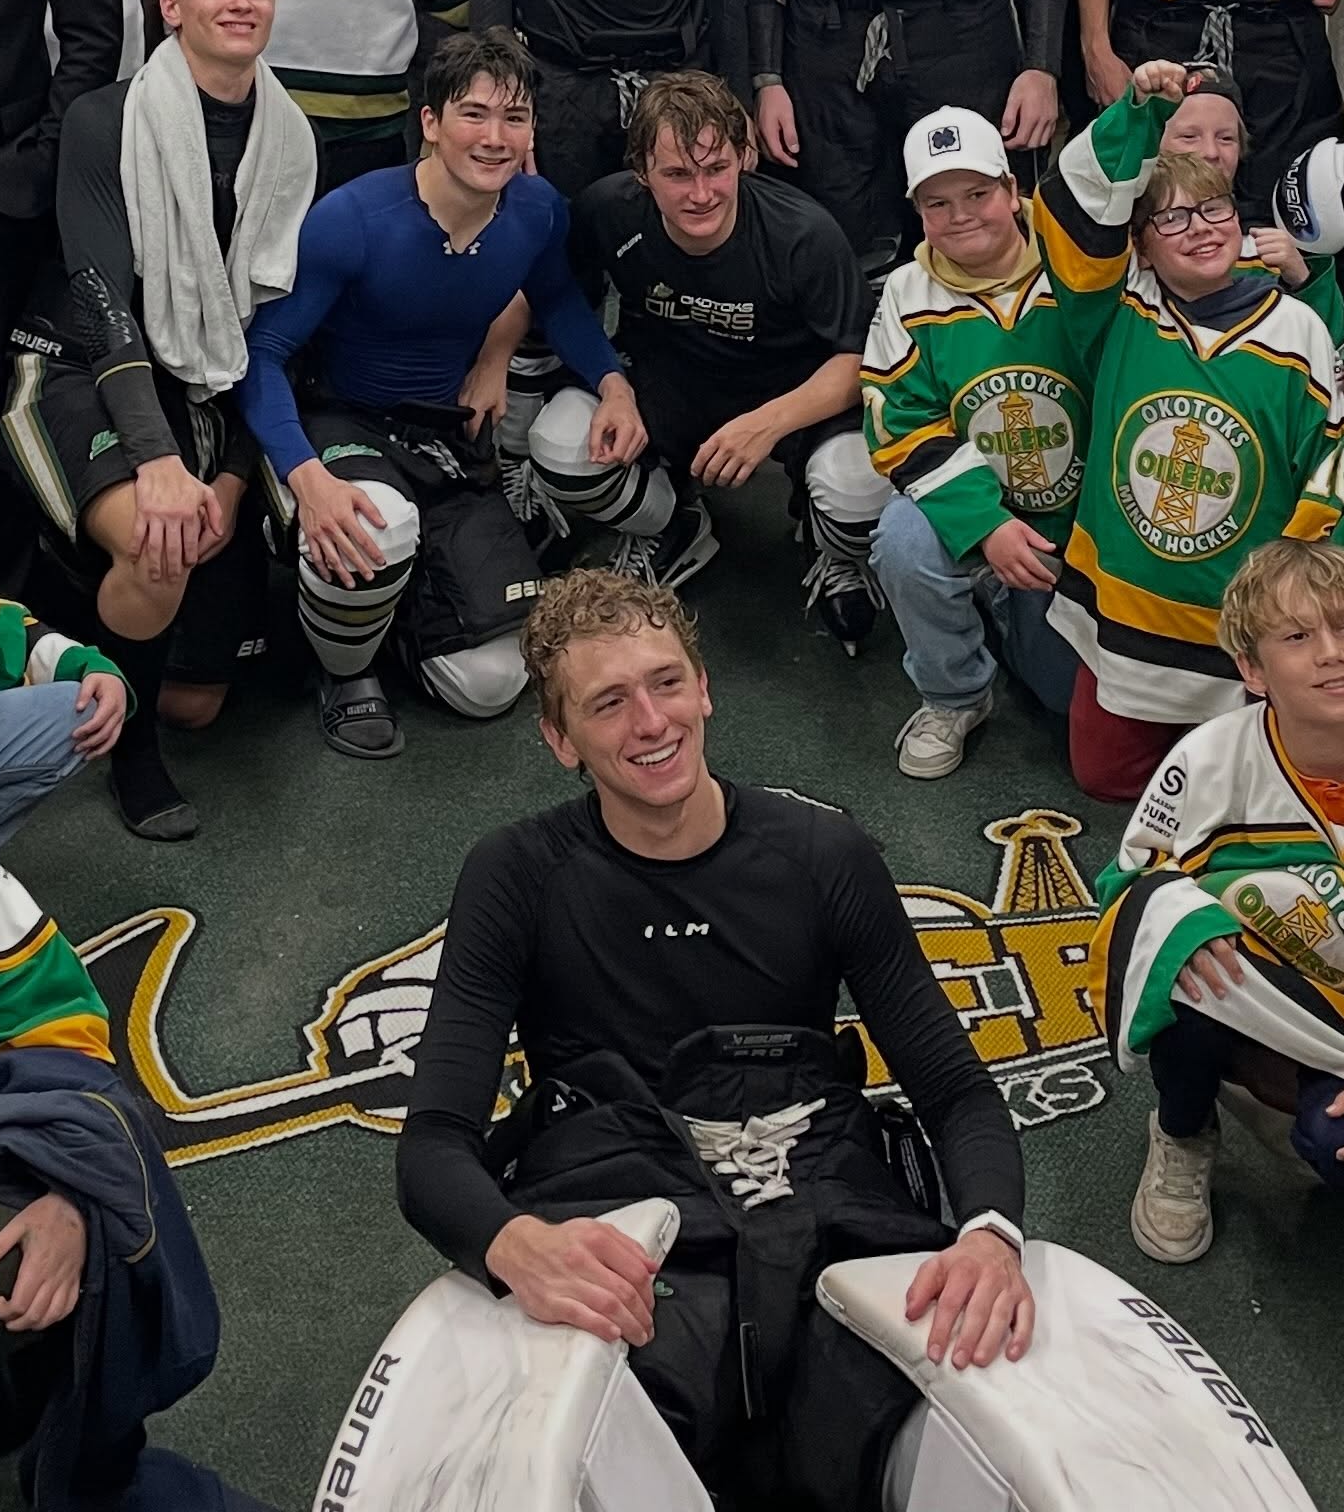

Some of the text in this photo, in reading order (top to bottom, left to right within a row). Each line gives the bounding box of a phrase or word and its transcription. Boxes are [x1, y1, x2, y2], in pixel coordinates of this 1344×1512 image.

[645, 297, 755, 330] OILERS
[962, 371, 1066, 412] OKOTOKS
[974, 421, 1069, 456] OILERS
[1141, 396, 1252, 449] OKOTOKS
[1028, 454, 1087, 510] HOCKEY
[1134, 449, 1235, 500] OILERS
[1117, 483, 1241, 555] MINOR HOCKEY
[1118, 1297, 1274, 1449] BAUER
